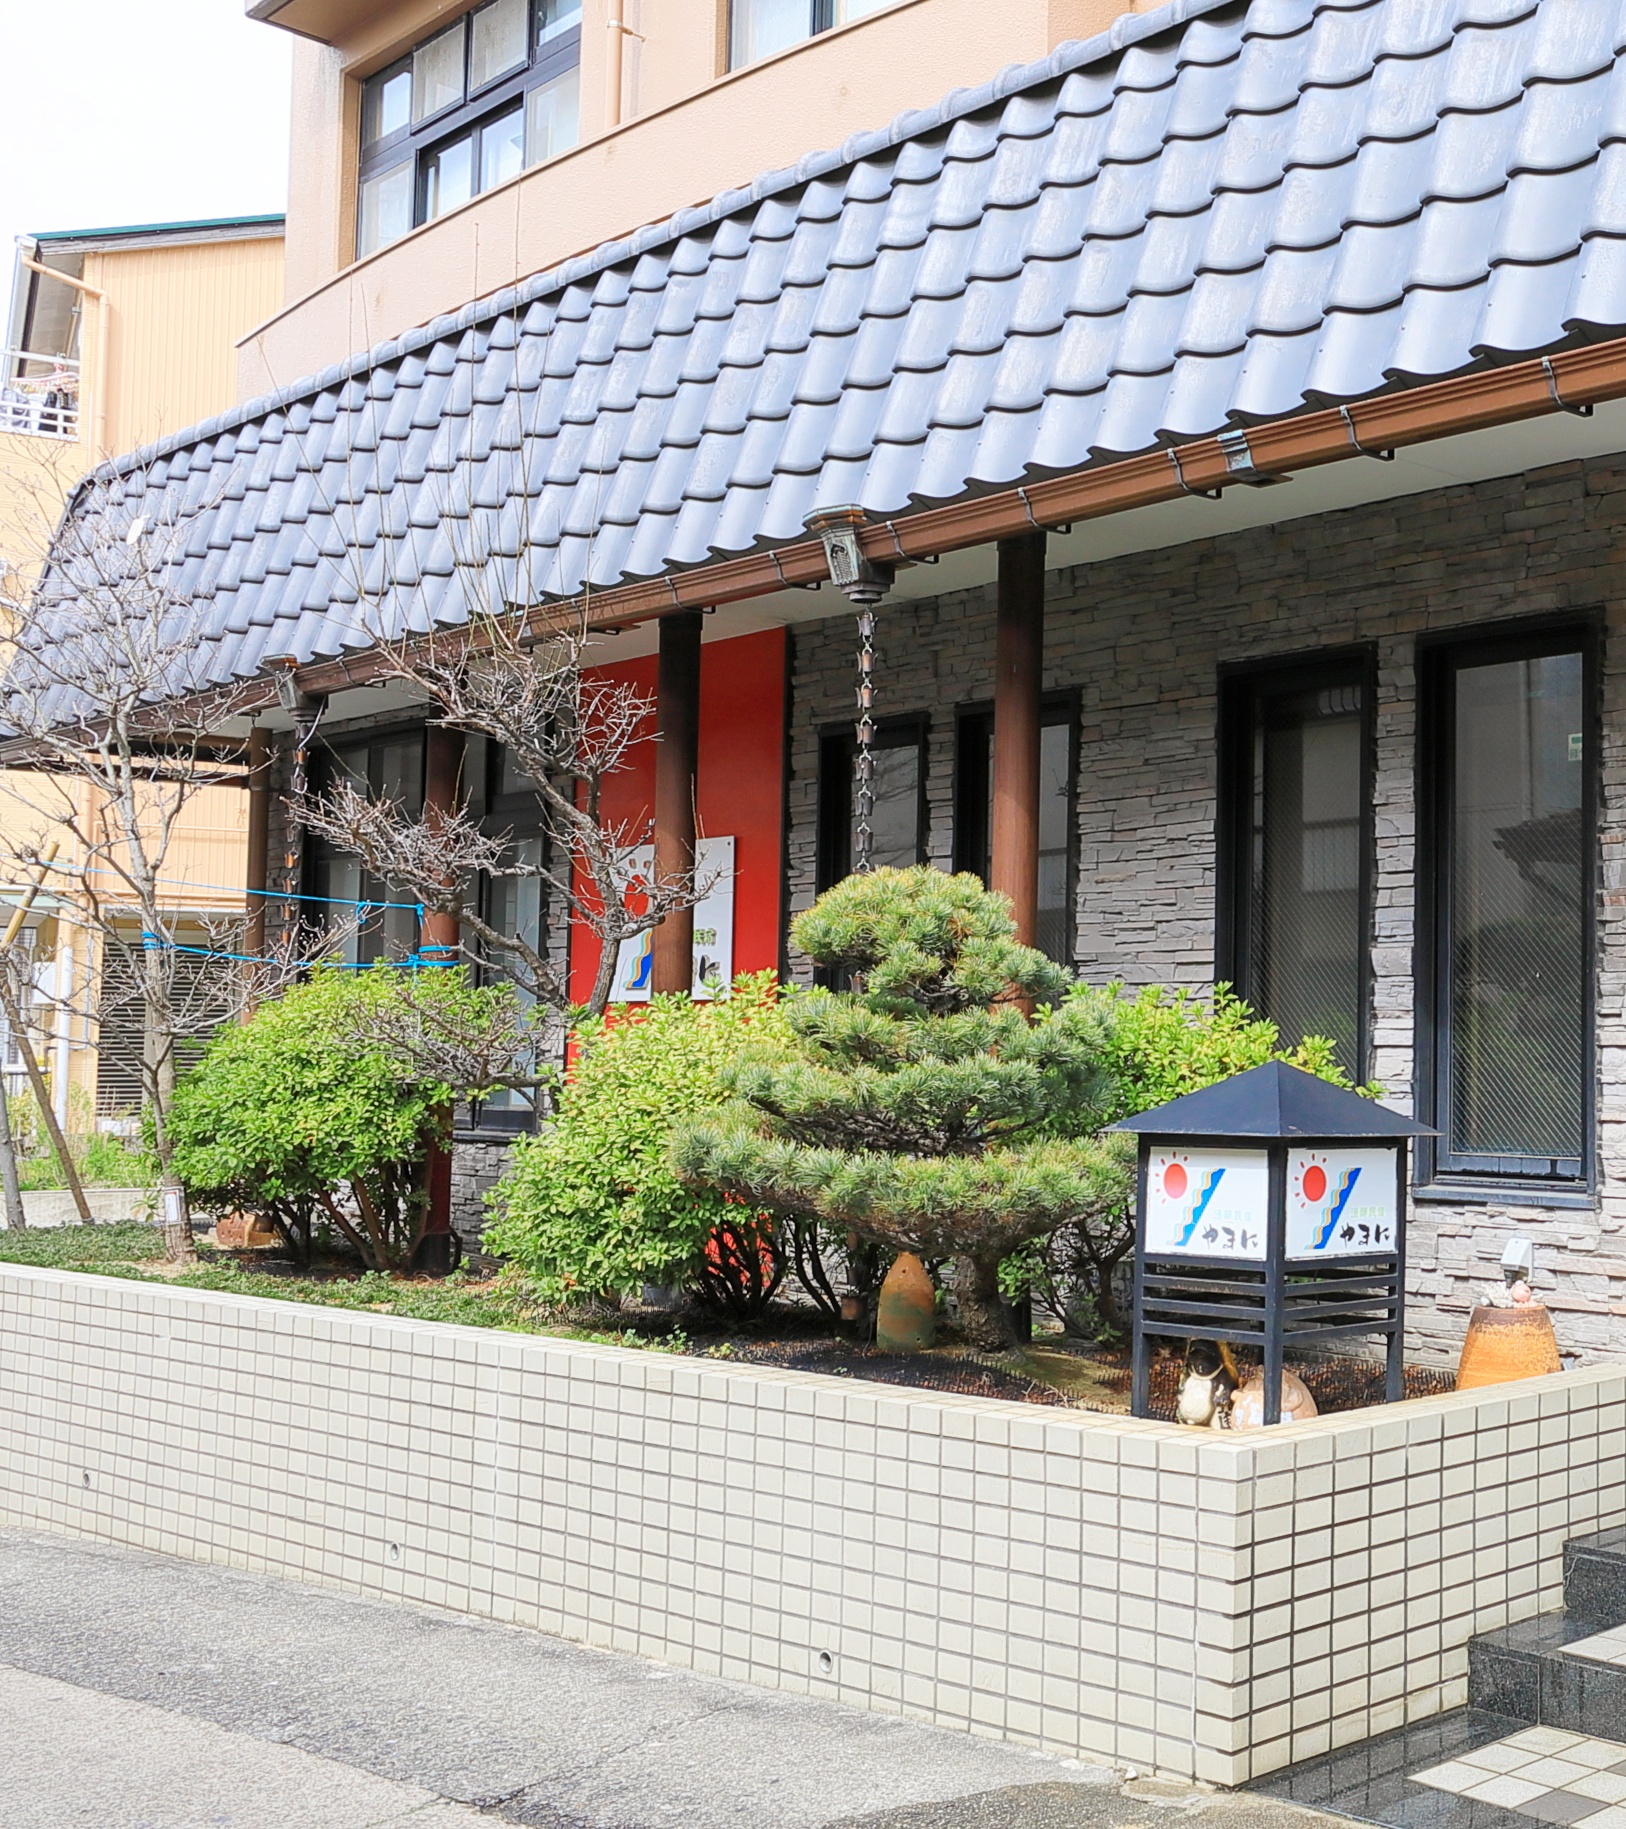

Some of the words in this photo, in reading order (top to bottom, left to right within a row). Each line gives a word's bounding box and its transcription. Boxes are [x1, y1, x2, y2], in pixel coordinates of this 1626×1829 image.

[1202, 1223, 1259, 1250] やまに
[1340, 1222, 1390, 1249] やまに
